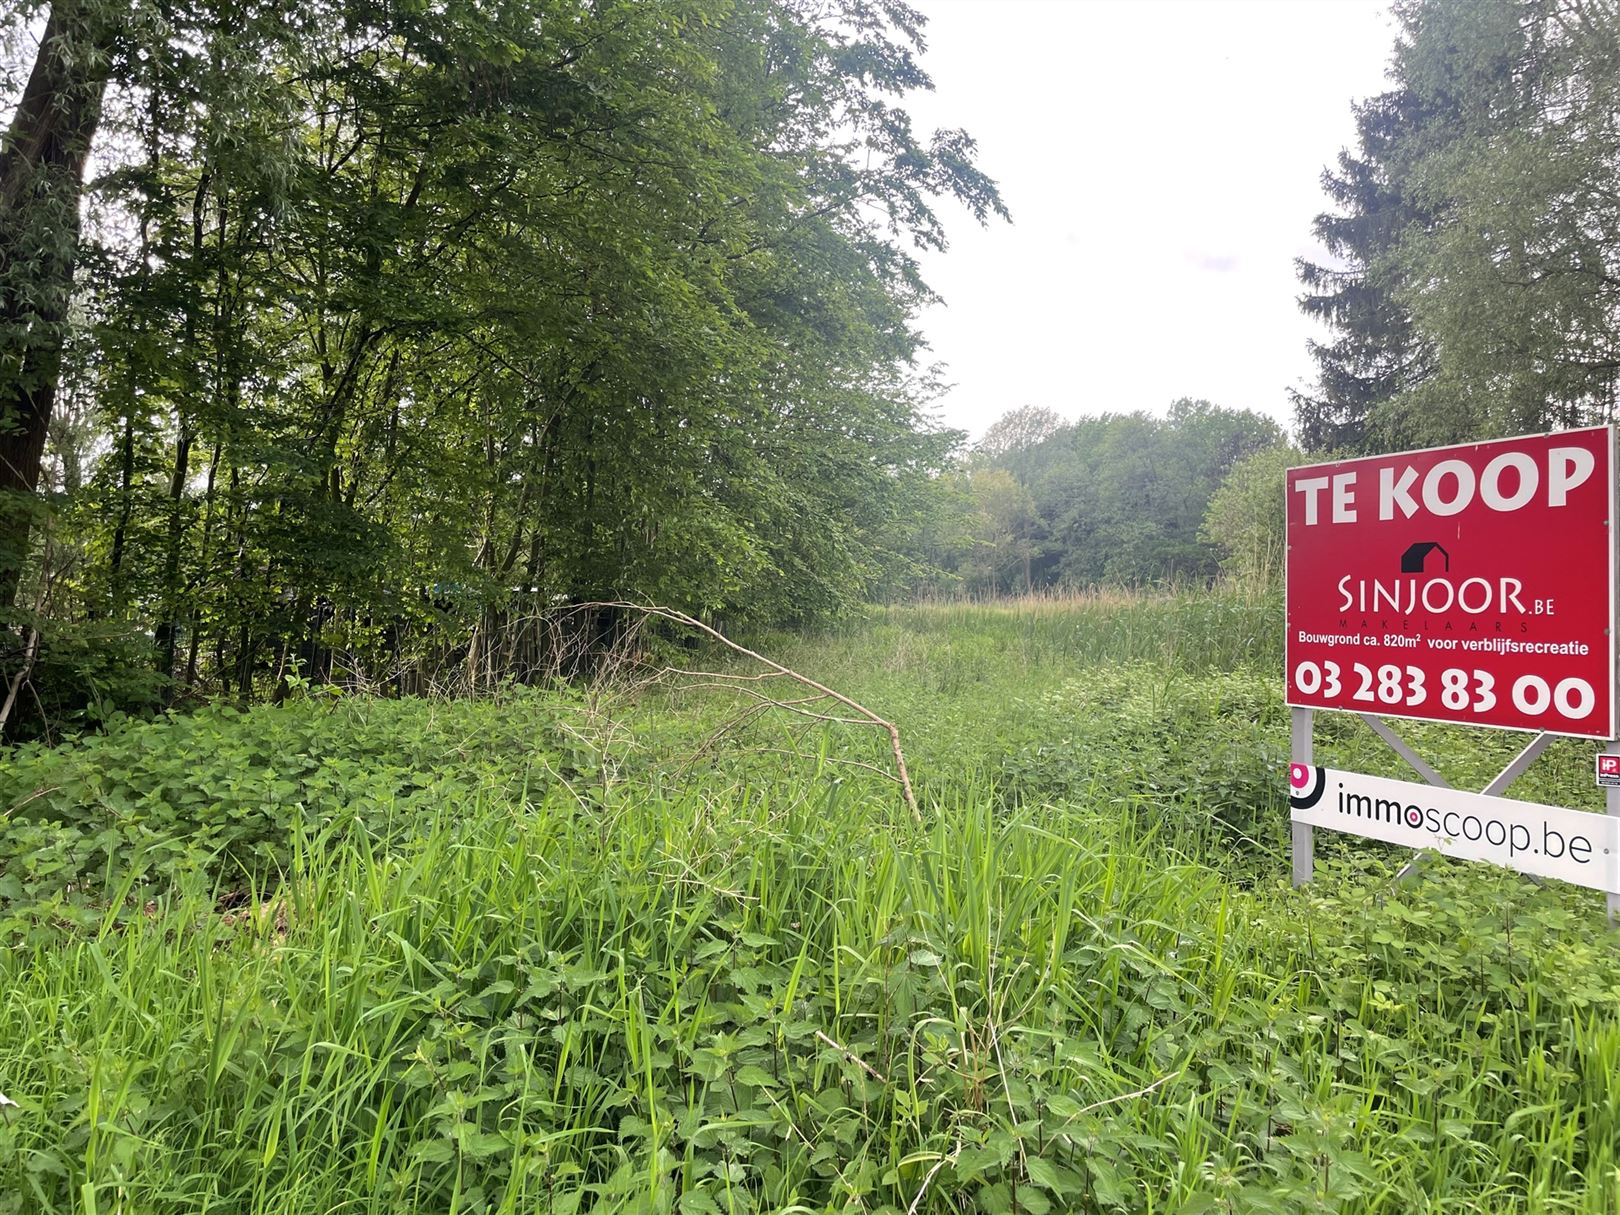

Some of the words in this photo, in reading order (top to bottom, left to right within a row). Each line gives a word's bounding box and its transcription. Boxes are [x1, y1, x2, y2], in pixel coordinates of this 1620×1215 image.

[1295, 472, 1357, 525] TE
[1379, 447, 1595, 521] KOOP
[1298, 631, 1360, 647] Bouwgrond
[1363, 636, 1380, 647] ca.
[1427, 638, 1458, 650] voor
[1461, 639, 1589, 656] verblijfsrecreatie
[1339, 619, 1528, 633] MAKELAARS
[1295, 660, 1342, 698] 03
[1353, 663, 1427, 706] 283
[1441, 668, 1496, 712] 83
[1512, 674, 1595, 720] 00
[1338, 782, 1592, 864] immoscoop.be
